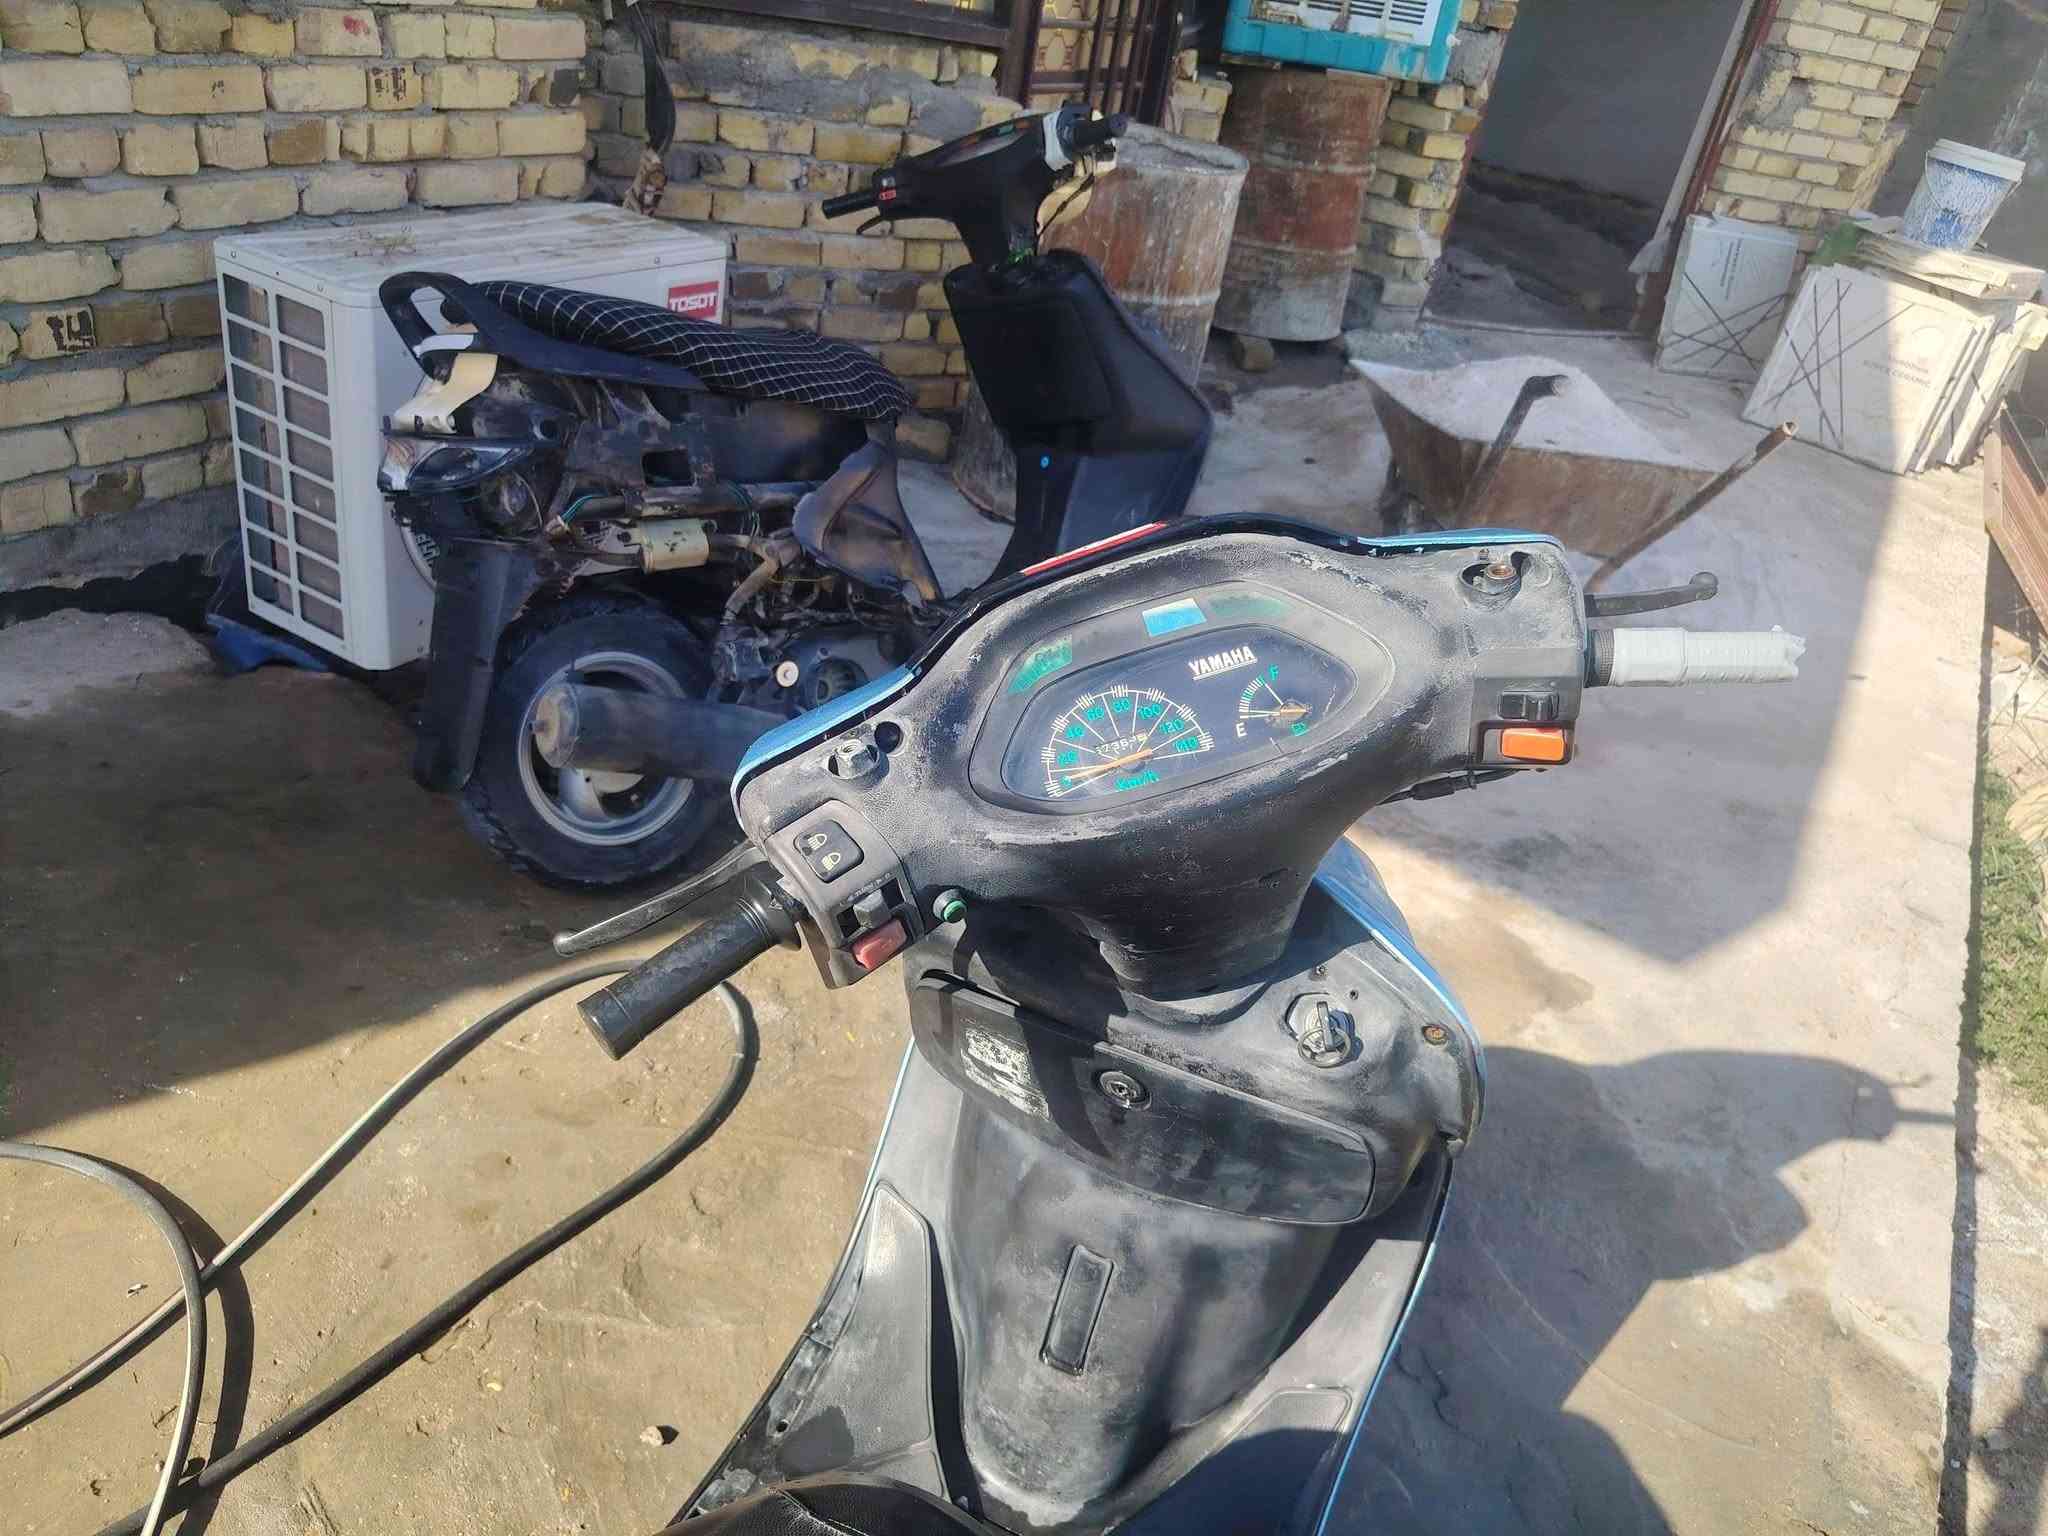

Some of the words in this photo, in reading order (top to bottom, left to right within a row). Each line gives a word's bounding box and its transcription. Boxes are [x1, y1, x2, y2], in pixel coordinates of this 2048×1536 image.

[669, 292, 718, 312] TOSOT
[1188, 645, 1257, 677] YAMAHA
[1268, 663, 1279, 682] F
[1160, 718, 1185, 735] 120
[1235, 721, 1248, 738] E
